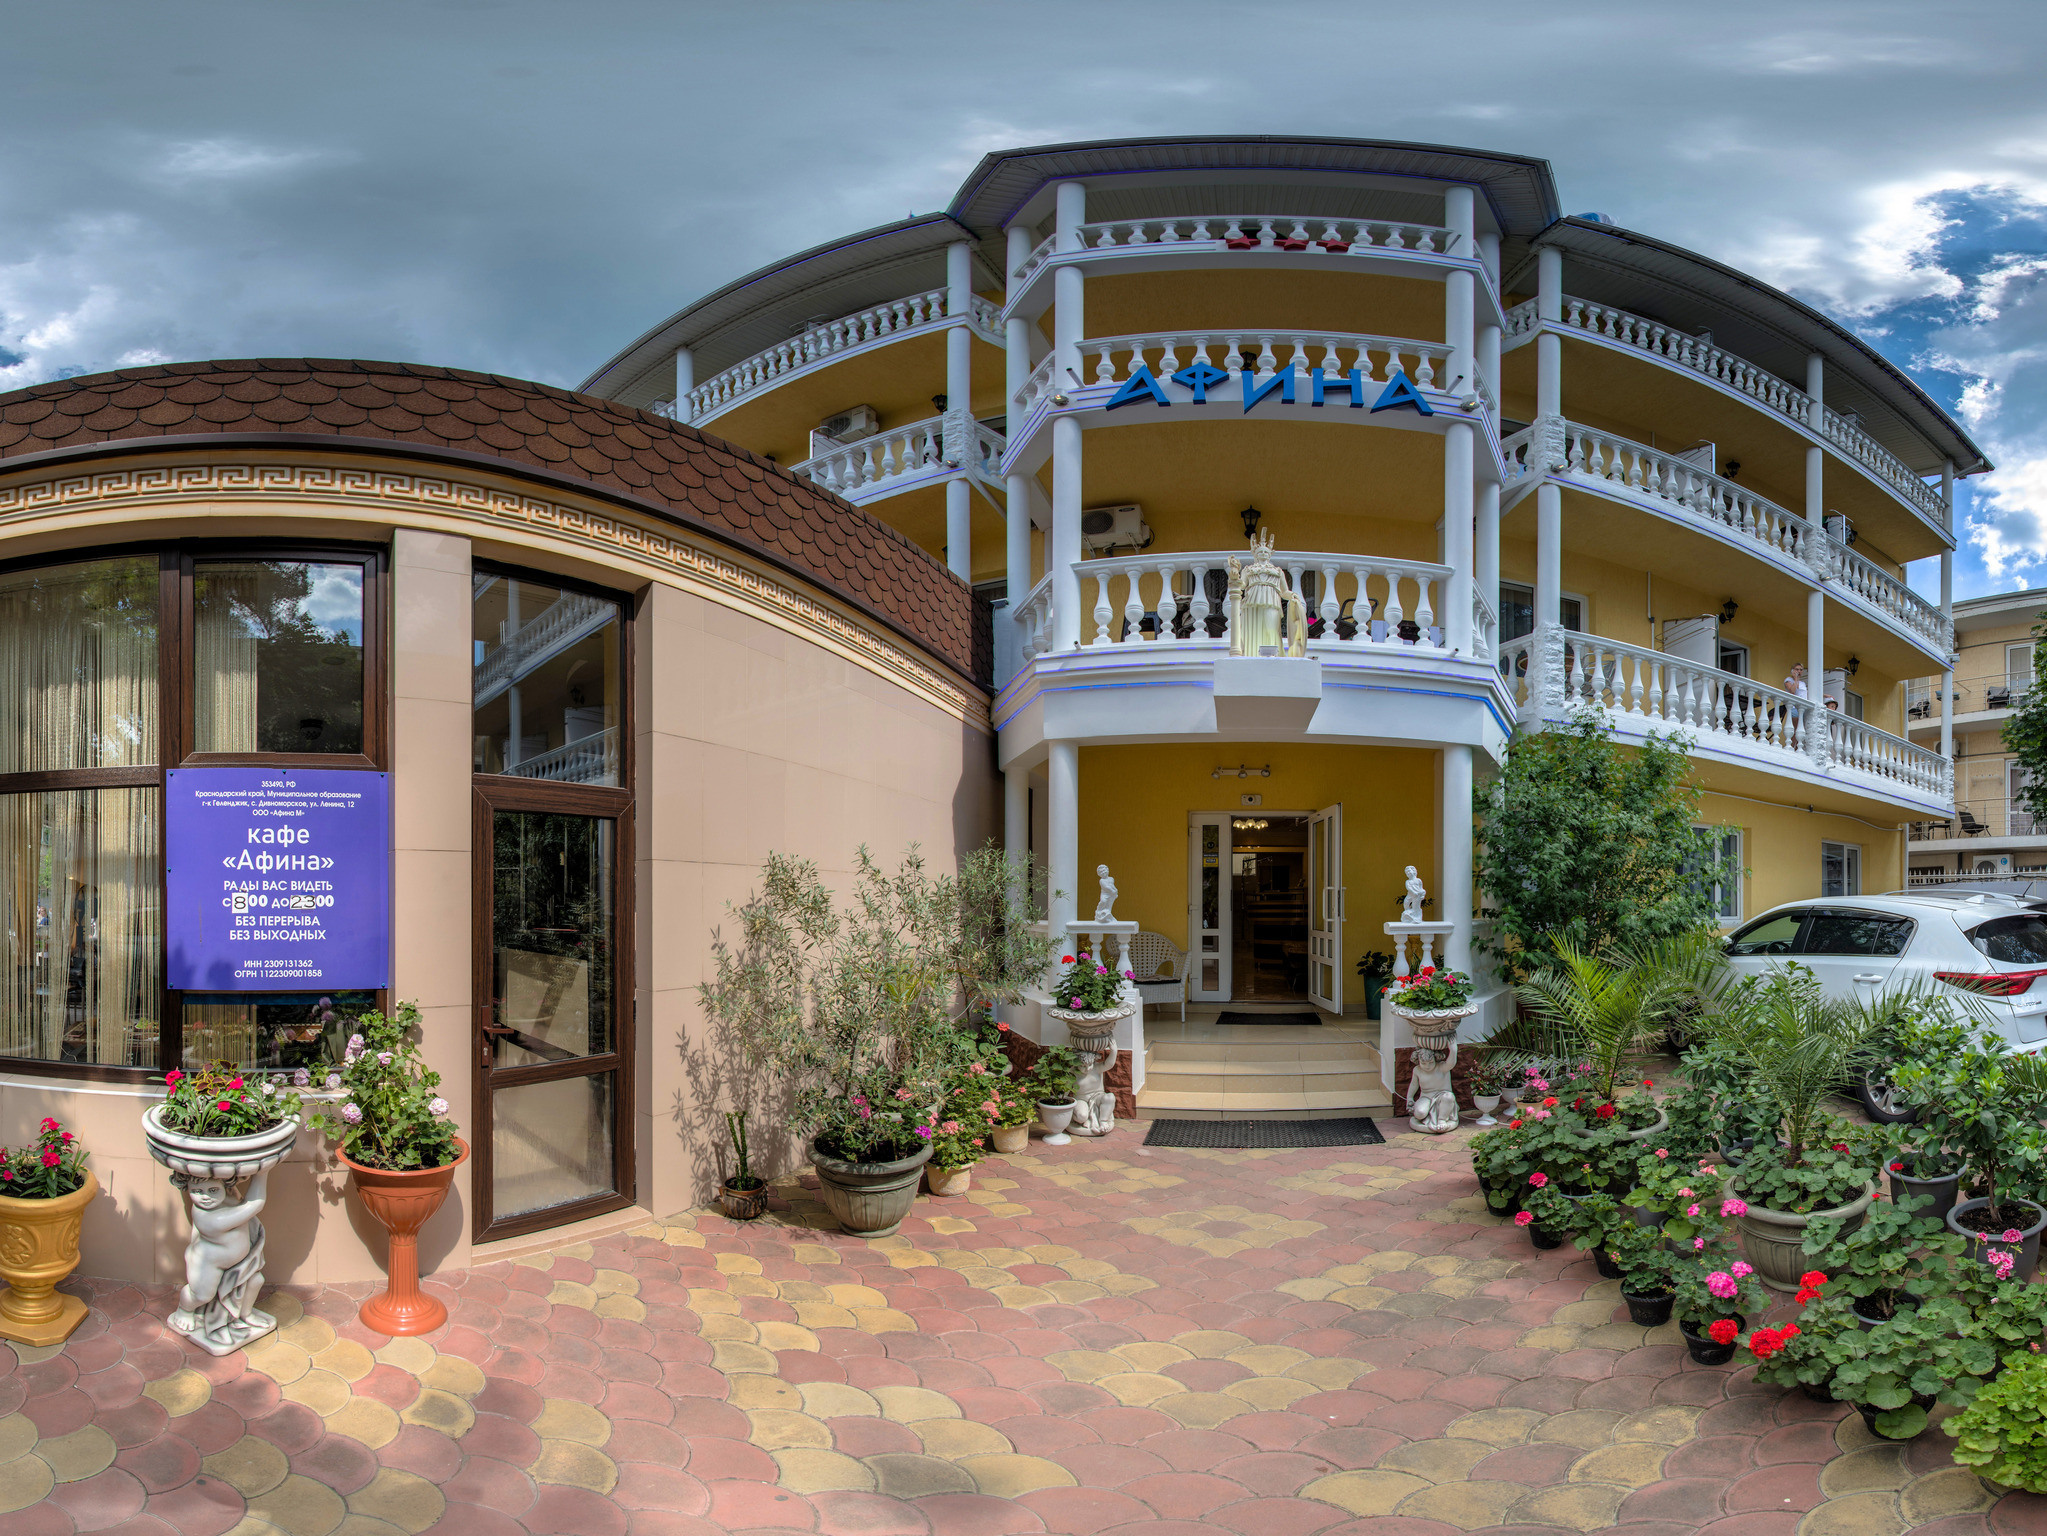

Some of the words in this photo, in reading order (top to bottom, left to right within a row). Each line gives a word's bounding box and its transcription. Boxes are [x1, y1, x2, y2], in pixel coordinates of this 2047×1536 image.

[1106, 361, 1434, 416] АФИНА
[261, 780, 285, 788] 353490,
[285, 780, 296, 788] РФ
[195, 790, 247, 798] Краснодарский
[248, 790, 266, 798] край,
[267, 790, 318, 798] Муниципальное
[319, 791, 361, 799] образование
[258, 800, 308, 808] Дивноморское,
[320, 800, 346, 808] Ленина,
[247, 825, 310, 847] кафе
[222, 849, 335, 874] «Афина»
[223, 880, 259, 893] РАДЫ
[262, 880, 288, 891] ВАС
[290, 880, 333, 893] ВИДЕТЬ
[235, 915, 256, 926] БЕЗ
[259, 915, 321, 926] ПЕРЕРЫВА
[229, 929, 250, 940] БЕЗ
[253, 929, 326, 942] ВЫХОДНЫХ
[244, 960, 262, 968] ИНН
[264, 960, 313, 968] 2309131362
[234, 970, 257, 978] ОГРН
[260, 969, 323, 978] 1122309001858
